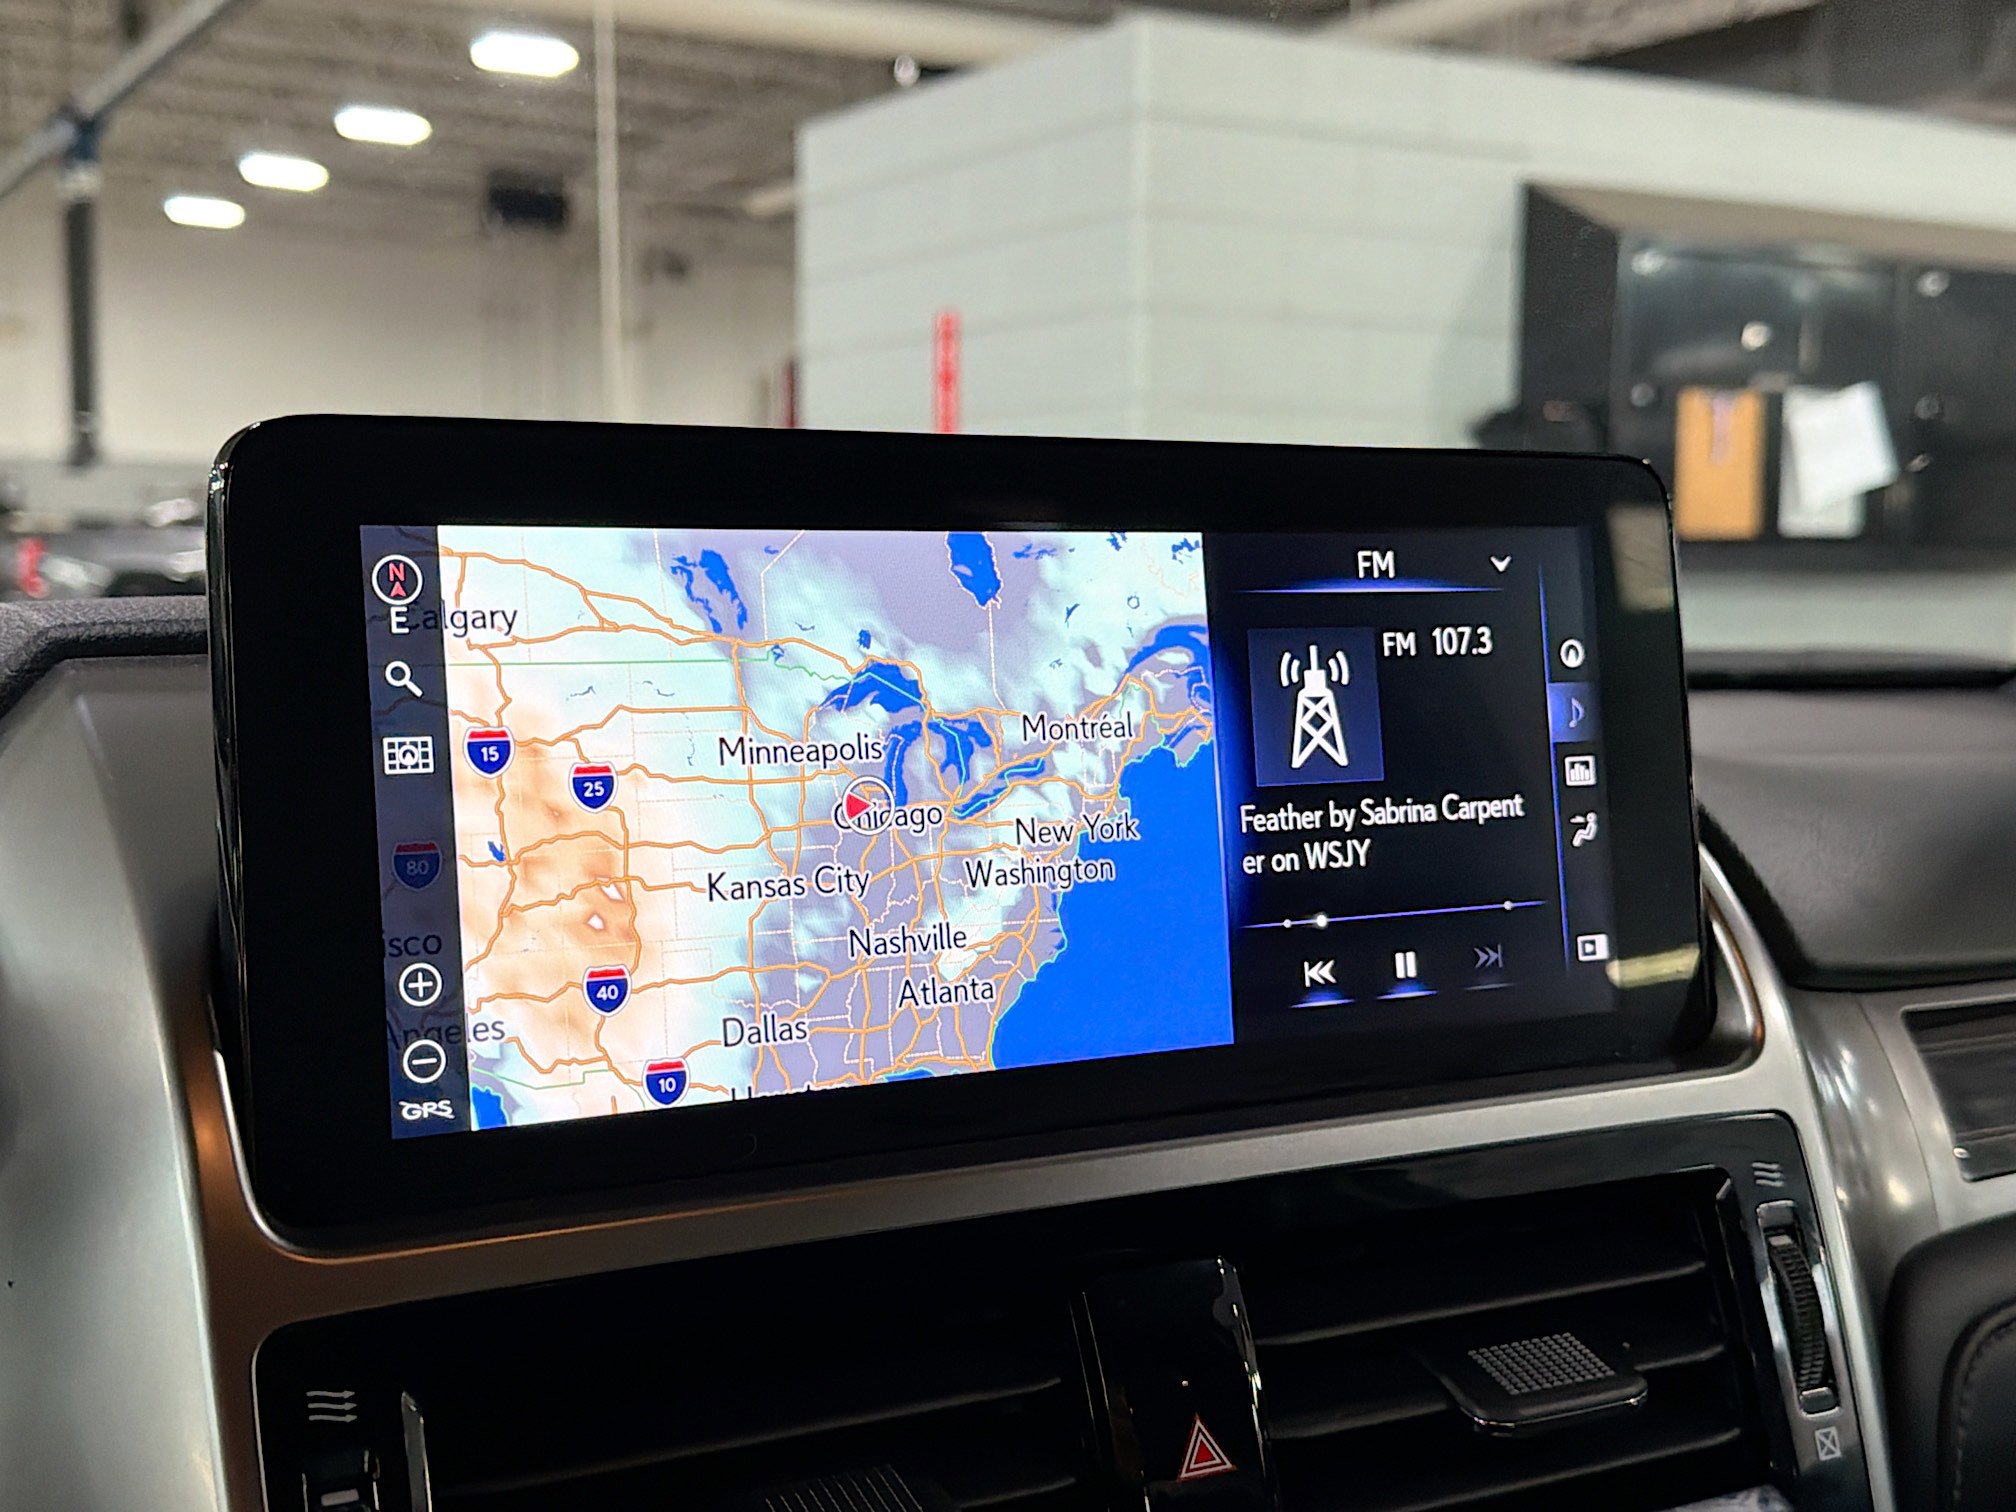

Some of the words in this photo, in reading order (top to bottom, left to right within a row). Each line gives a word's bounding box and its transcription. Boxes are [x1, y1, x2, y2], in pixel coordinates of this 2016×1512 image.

[388, 562, 405, 582] N
[1357, 550, 1395, 579] FM
[390, 606, 410, 634] E
[1382, 631, 1417, 657] FM
[1431, 626, 1493, 656] 107.3
[1022, 711, 1133, 741] Montréal
[480, 745, 500, 762] 15
[719, 732, 883, 769] Minneapolis
[583, 781, 605, 798] 25
[1015, 817, 1074, 845] New
[1083, 812, 1140, 840] York
[1240, 802, 1324, 834] Feather
[1328, 799, 1357, 833] by
[1360, 796, 1438, 827] Sabrina
[1441, 793, 1525, 825] Carpent
[406, 860, 428, 876] 80
[1242, 854, 1266, 875] er
[1271, 852, 1300, 874] on
[1303, 838, 1371, 870] WSJY
[708, 872, 805, 902] Kansas
[815, 865, 869, 898] City
[965, 857, 1113, 889] Washington
[849, 922, 967, 957] Nashville
[596, 984, 619, 1001] 40
[898, 977, 994, 1008] Atlanta
[723, 1014, 807, 1047] Dallas
[658, 1077, 677, 1093] 10
